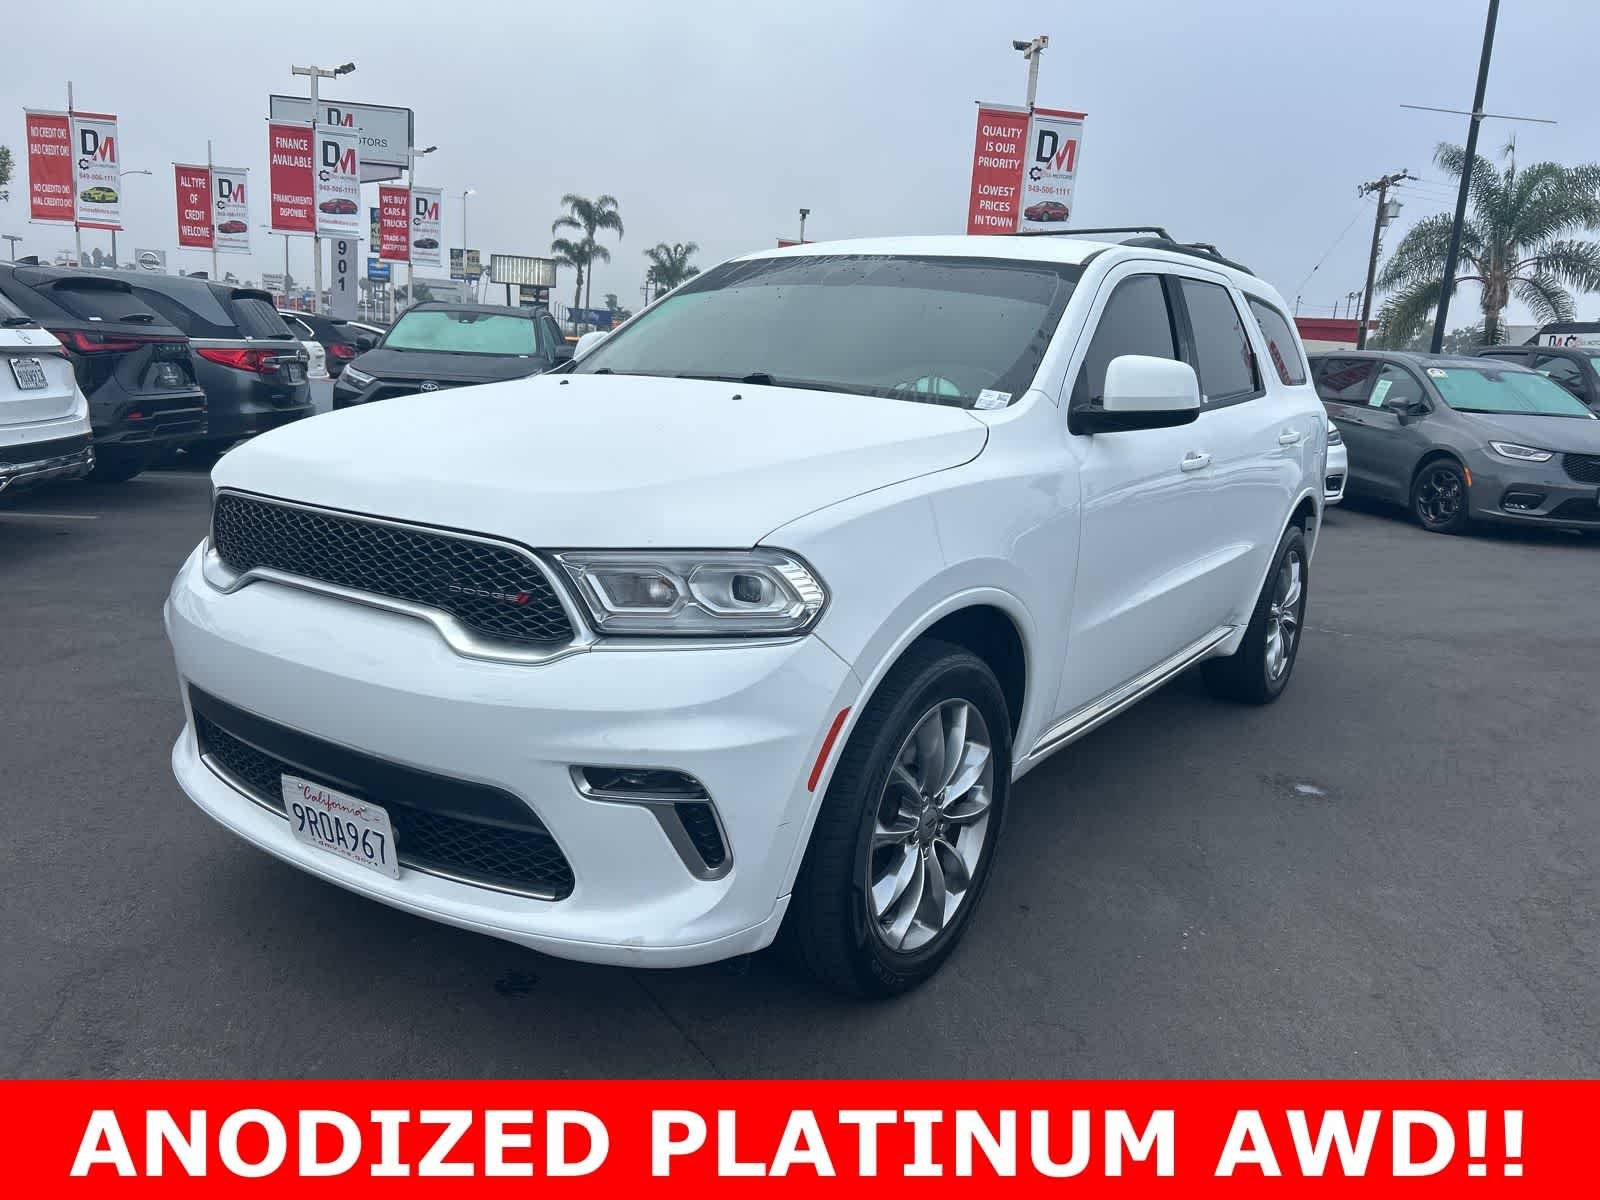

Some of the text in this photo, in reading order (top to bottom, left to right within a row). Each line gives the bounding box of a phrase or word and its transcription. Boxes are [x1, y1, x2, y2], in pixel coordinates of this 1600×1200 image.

[327, 107, 353, 128] DM
[31, 127, 39, 137] NO
[40, 127, 57, 139] CREDIT
[982, 125, 1023, 139] QUALITY
[31, 143, 41, 154] BAD
[42, 144, 59, 156] CREDIT
[81, 129, 115, 163] DM
[276, 136, 308, 151] FINANCE
[985, 141, 1016, 154] IS OUR
[1035, 129, 1077, 172] DM
[272, 154, 312, 169] AVAILABLE
[322, 140, 356, 175] DM
[978, 156, 1021, 170] PRIORITY
[34, 184, 41, 193] NO
[180, 176, 206, 189] ALL TYPE
[218, 178, 245, 204] DM
[978, 184, 1015, 197] LOWEST
[190, 193, 198, 204] OF
[382, 195, 408, 205] WE BUY
[279, 207, 307, 218] DISPONIBLE
[383, 207, 401, 216] CARS
[415, 197, 439, 221] DM
[979, 200, 1011, 212] PRICES
[185, 209, 205, 222] CREDIT
[974, 215, 1013, 227] IN TOWN
[382, 218, 408, 228] TRUCKS
[181, 226, 210, 239] WELCOME
[383, 234, 406, 243] TRADE-IN
[382, 243, 408, 252] ACCEPTED
[449, 585, 518, 602] DODGE
[303, 785, 366, 816] California
[292, 803, 385, 864] 9RDA967
